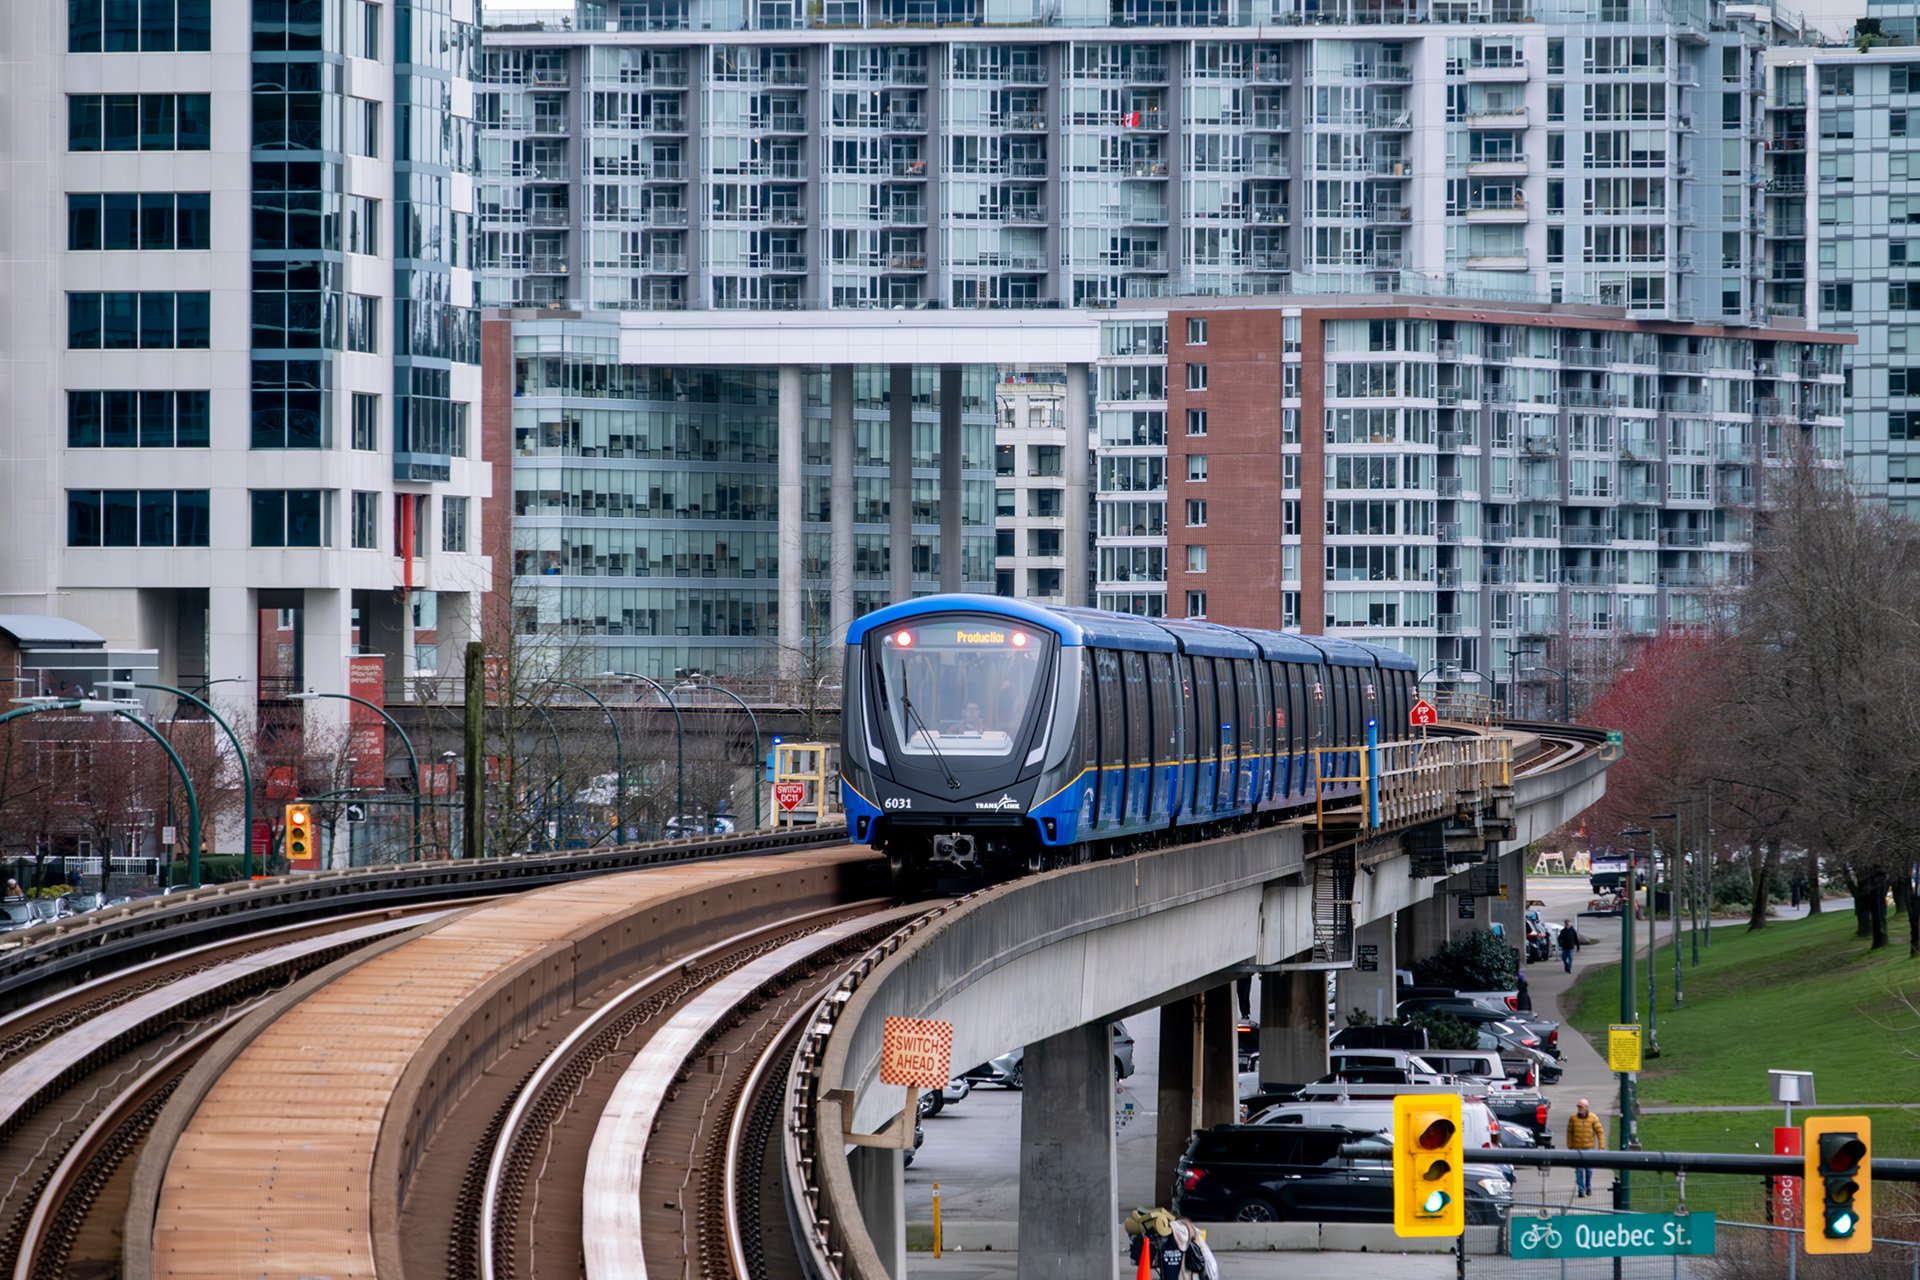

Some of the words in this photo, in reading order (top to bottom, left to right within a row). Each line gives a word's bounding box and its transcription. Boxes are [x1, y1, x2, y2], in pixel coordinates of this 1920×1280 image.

[351, 676, 378, 684] Profit.
[1417, 706, 1429, 715] FP
[1419, 715, 1429, 723] 12
[777, 785, 802, 794] SWITCH
[780, 793, 799, 802] DC11
[884, 798, 912, 809] 6031
[895, 1035, 940, 1054] SWITCH
[895, 1053, 935, 1072] AHEAD
[1575, 1223, 1655, 1250] Quebec
[1662, 1222, 1692, 1246] St.
